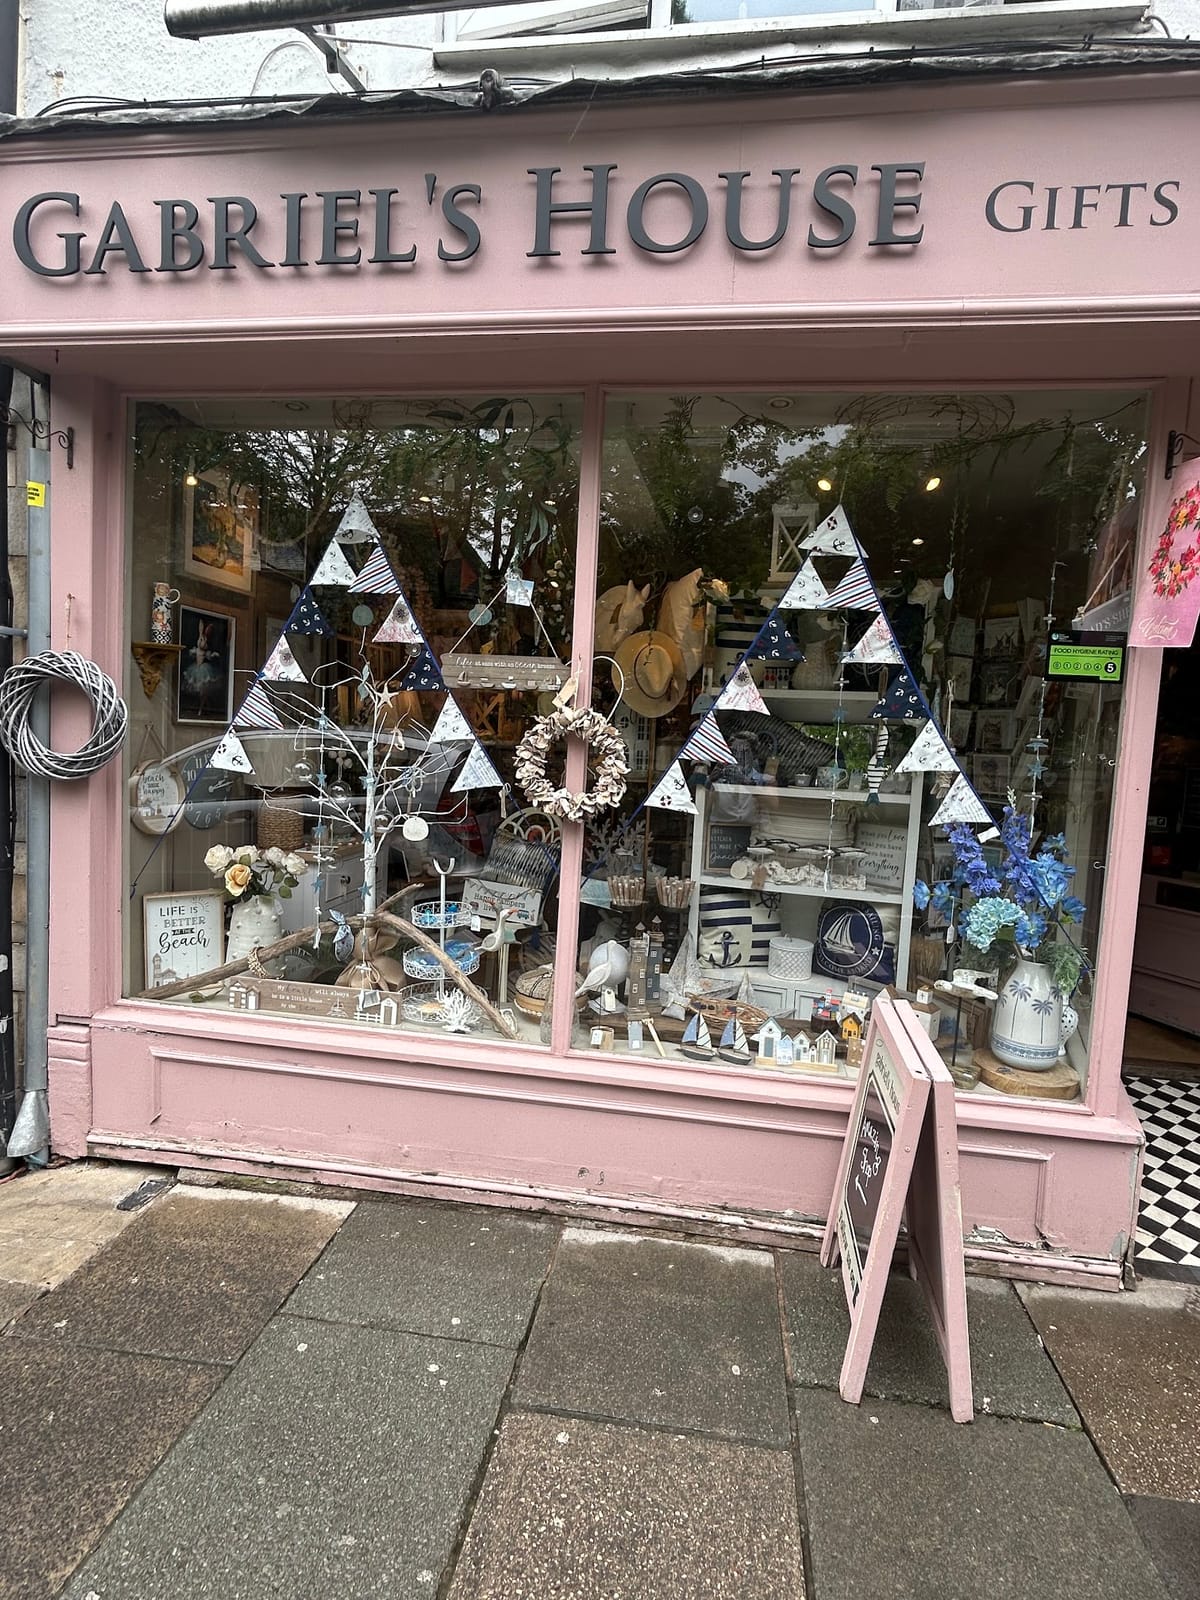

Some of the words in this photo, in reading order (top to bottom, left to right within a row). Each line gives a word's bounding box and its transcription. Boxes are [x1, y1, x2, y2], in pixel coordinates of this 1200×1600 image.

[985, 180, 1181, 234] GIFTS
[12, 173, 482, 277] GABRIEL'S
[526, 161, 926, 258] HOUSE
[1106, 663, 1114, 673] 5
[187, 769, 196, 781] 10
[160, 906, 186, 917] LIFE
[164, 916, 206, 928] BETTER
